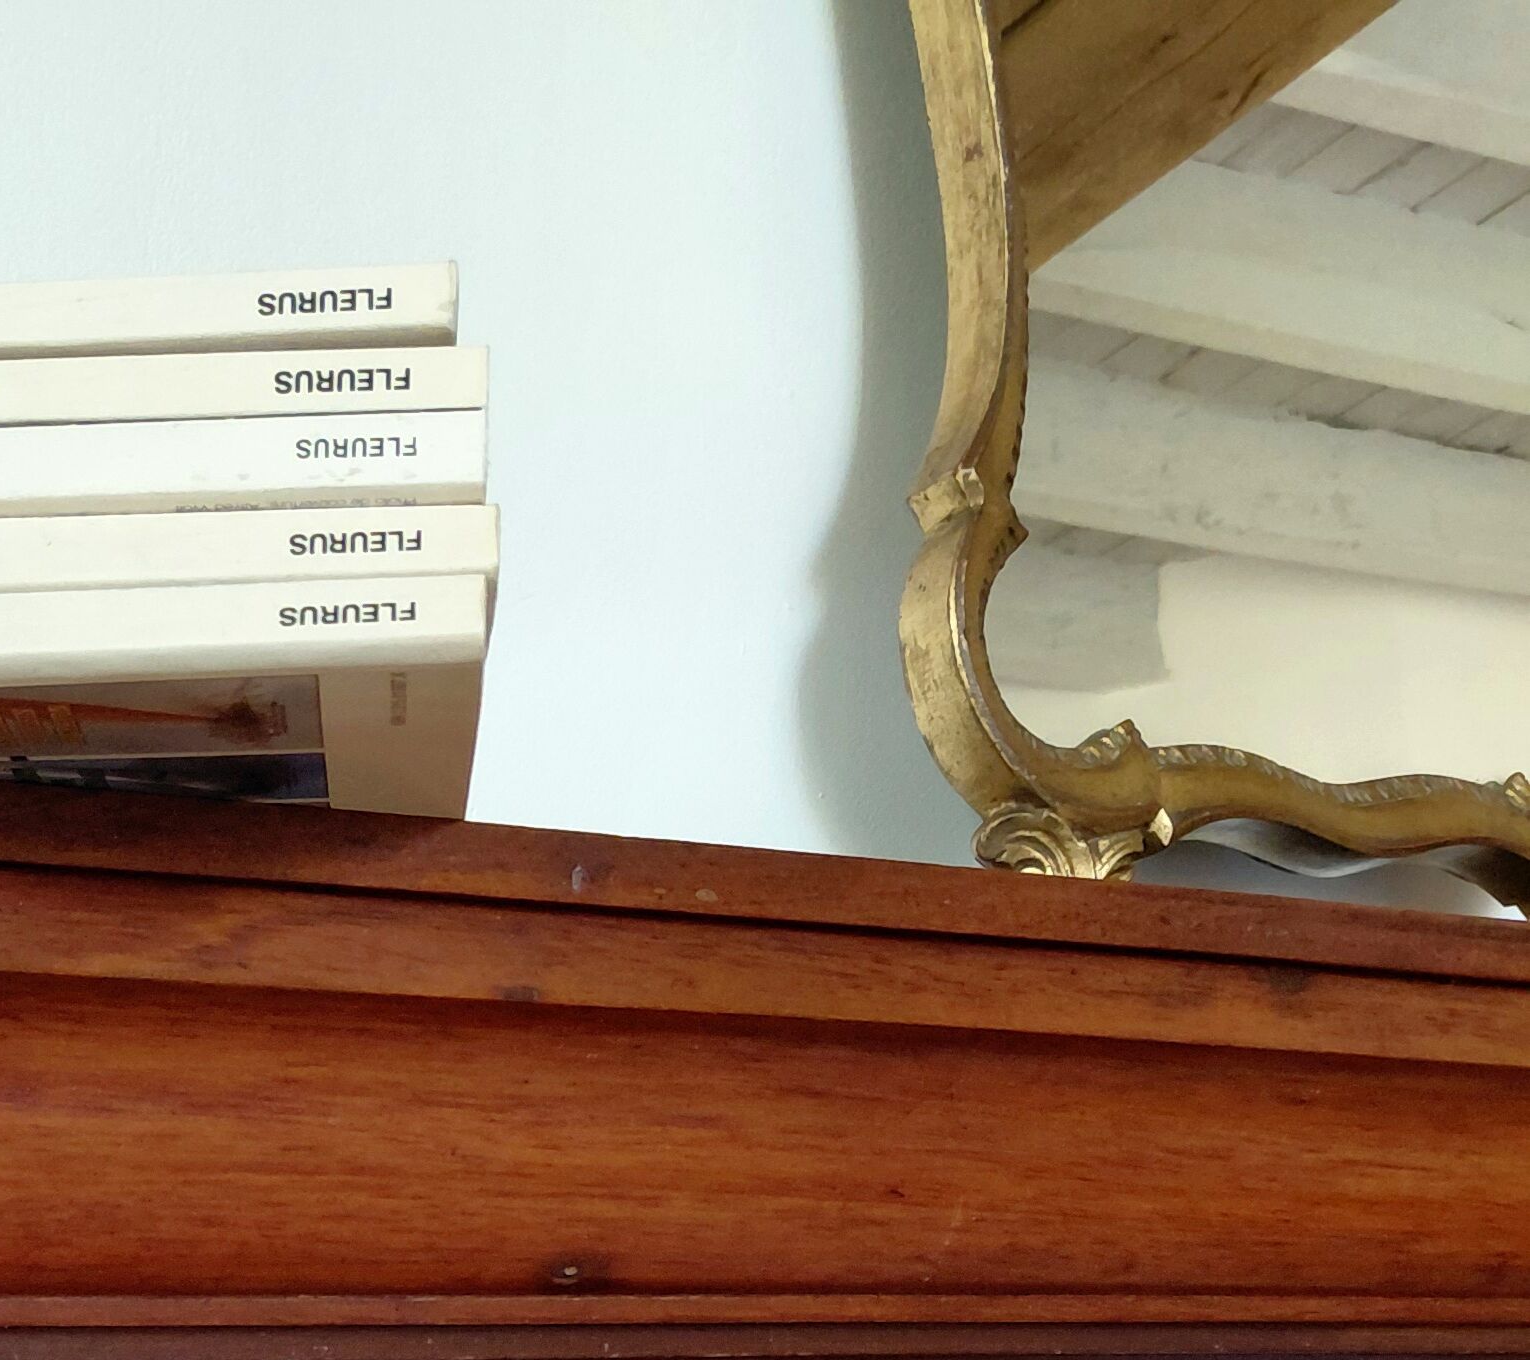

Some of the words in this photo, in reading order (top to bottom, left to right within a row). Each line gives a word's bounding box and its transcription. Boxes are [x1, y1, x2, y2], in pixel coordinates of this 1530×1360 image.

[257, 287, 392, 315] FLEURUS
[274, 367, 411, 394] FLEURUS
[296, 437, 417, 459] FLEURUS
[289, 530, 422, 555] FLEURUS
[279, 602, 416, 627] FLEURUS
